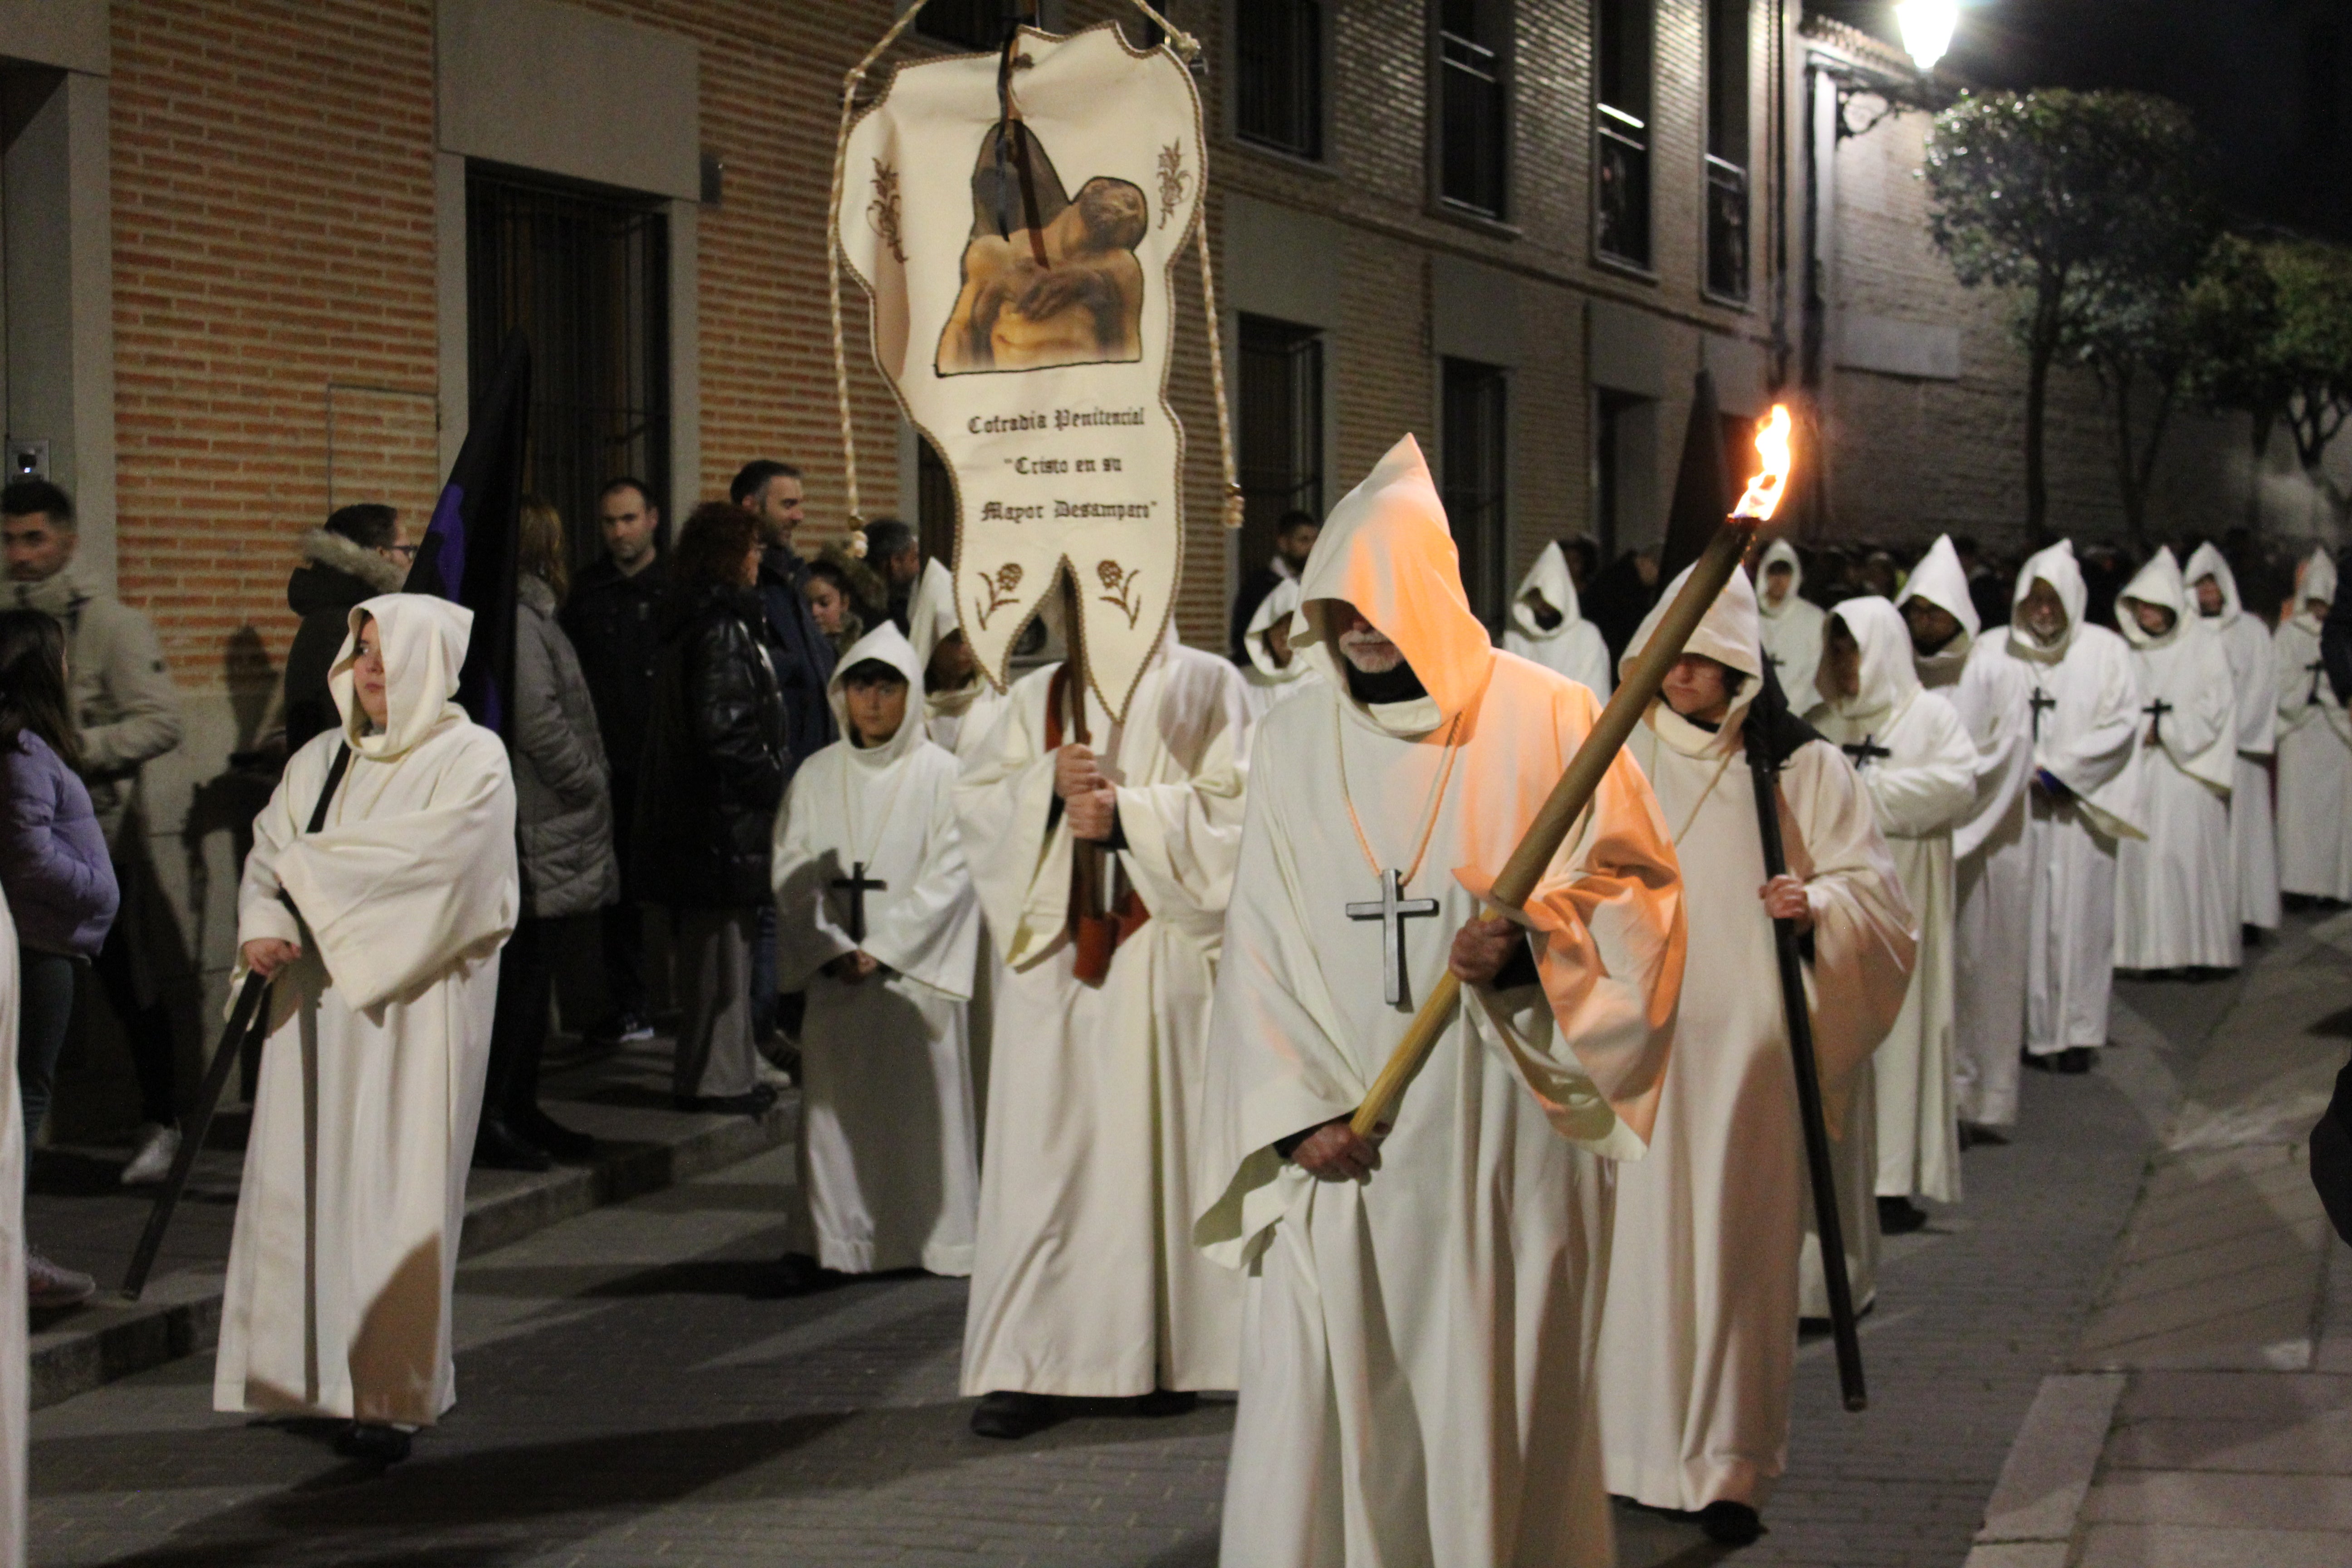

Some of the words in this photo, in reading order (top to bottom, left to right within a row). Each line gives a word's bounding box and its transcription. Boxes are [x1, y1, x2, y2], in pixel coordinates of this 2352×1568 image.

[1054, 407, 1145, 431] Penitencial
[1075, 459, 1096, 472] en
[1102, 457, 1122, 472] su
[981, 501, 1044, 523] Mayor
